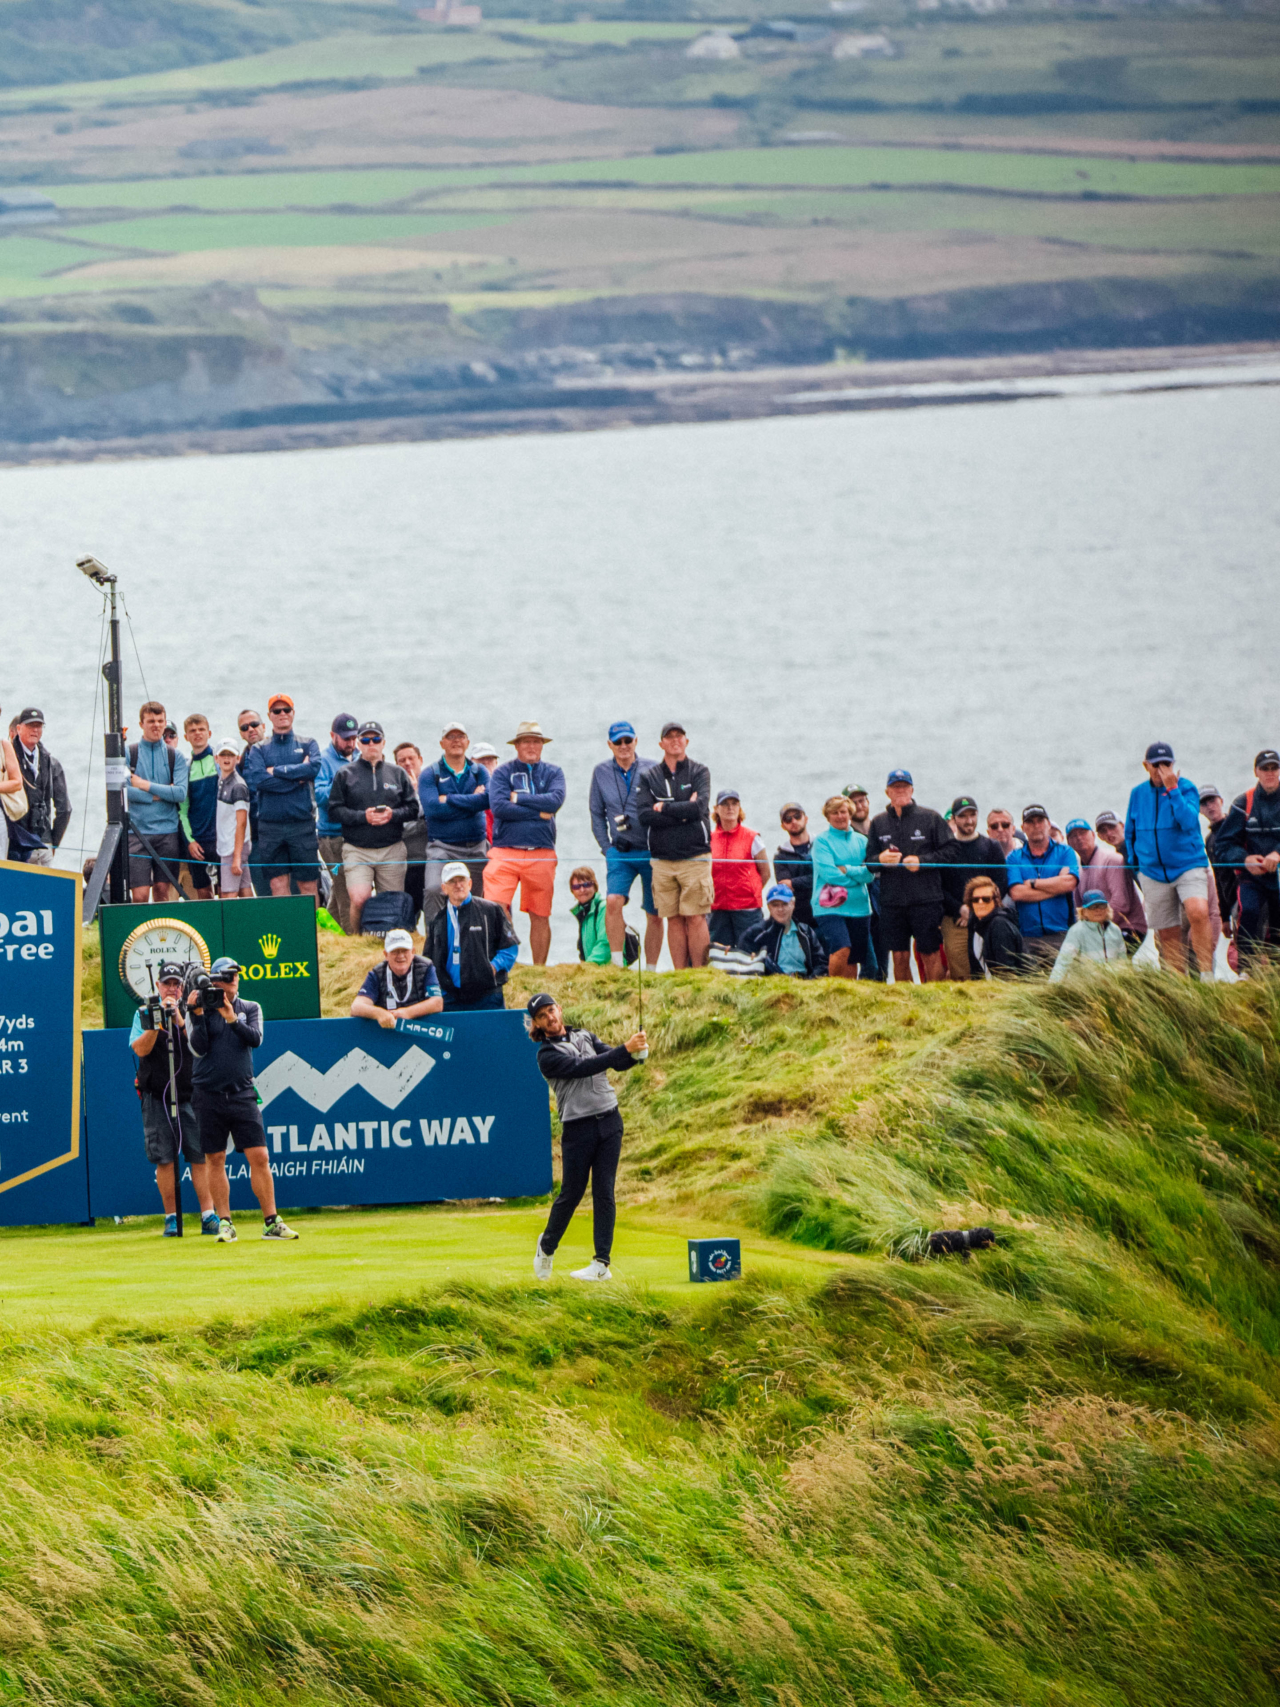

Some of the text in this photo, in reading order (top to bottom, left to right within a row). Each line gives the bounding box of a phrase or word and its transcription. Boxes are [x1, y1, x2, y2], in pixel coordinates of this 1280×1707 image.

[149, 946, 178, 954] ROLEX
[18, 1058, 29, 1075] 3
[267, 1120, 412, 1153] TLANTIC
[419, 1115, 496, 1147] WAY
[311, 1156, 365, 1175] FHIÁIN
